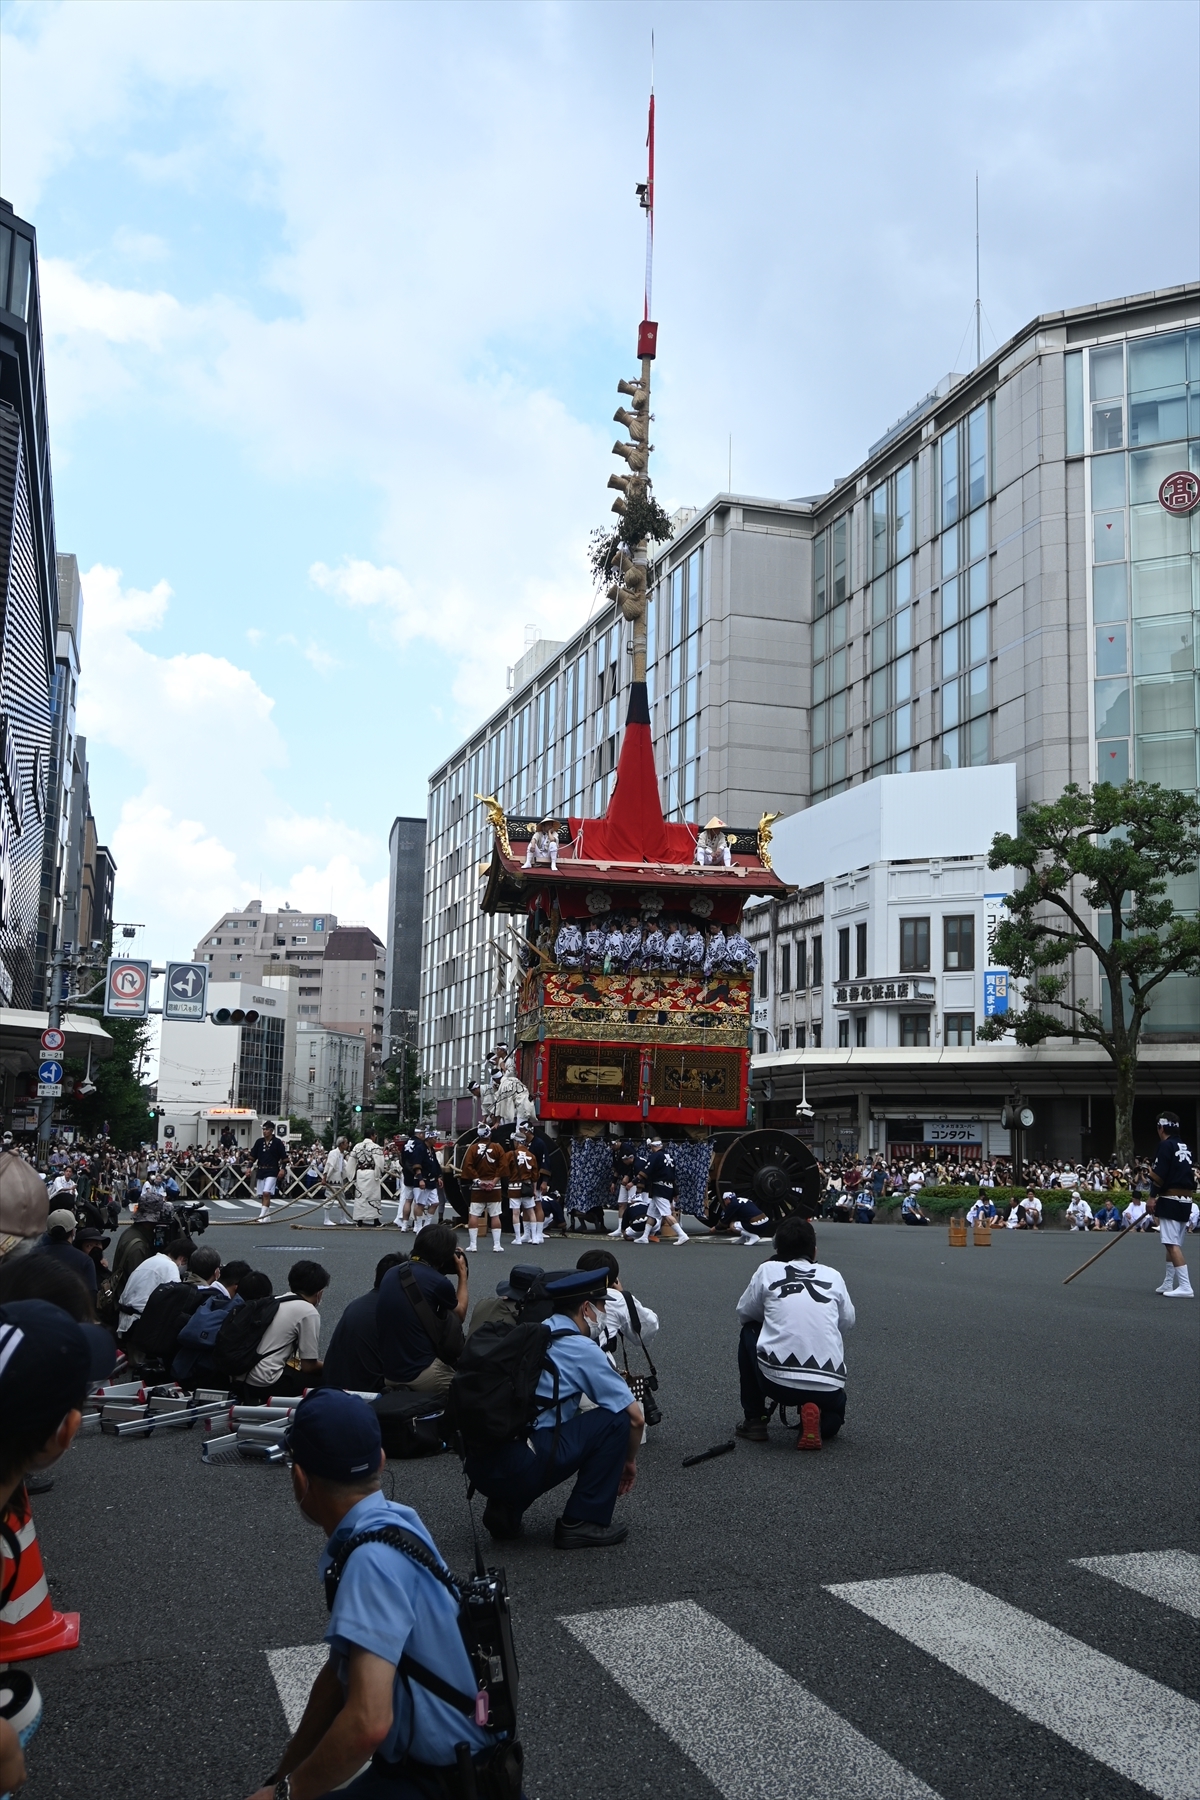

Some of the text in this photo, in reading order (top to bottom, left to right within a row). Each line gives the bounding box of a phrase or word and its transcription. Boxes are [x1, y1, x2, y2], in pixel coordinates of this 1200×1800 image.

[986, 975, 996, 1014] 買えます
[997, 975, 1005, 996] すぐ
[931, 1131, 975, 1140] コンタクト
